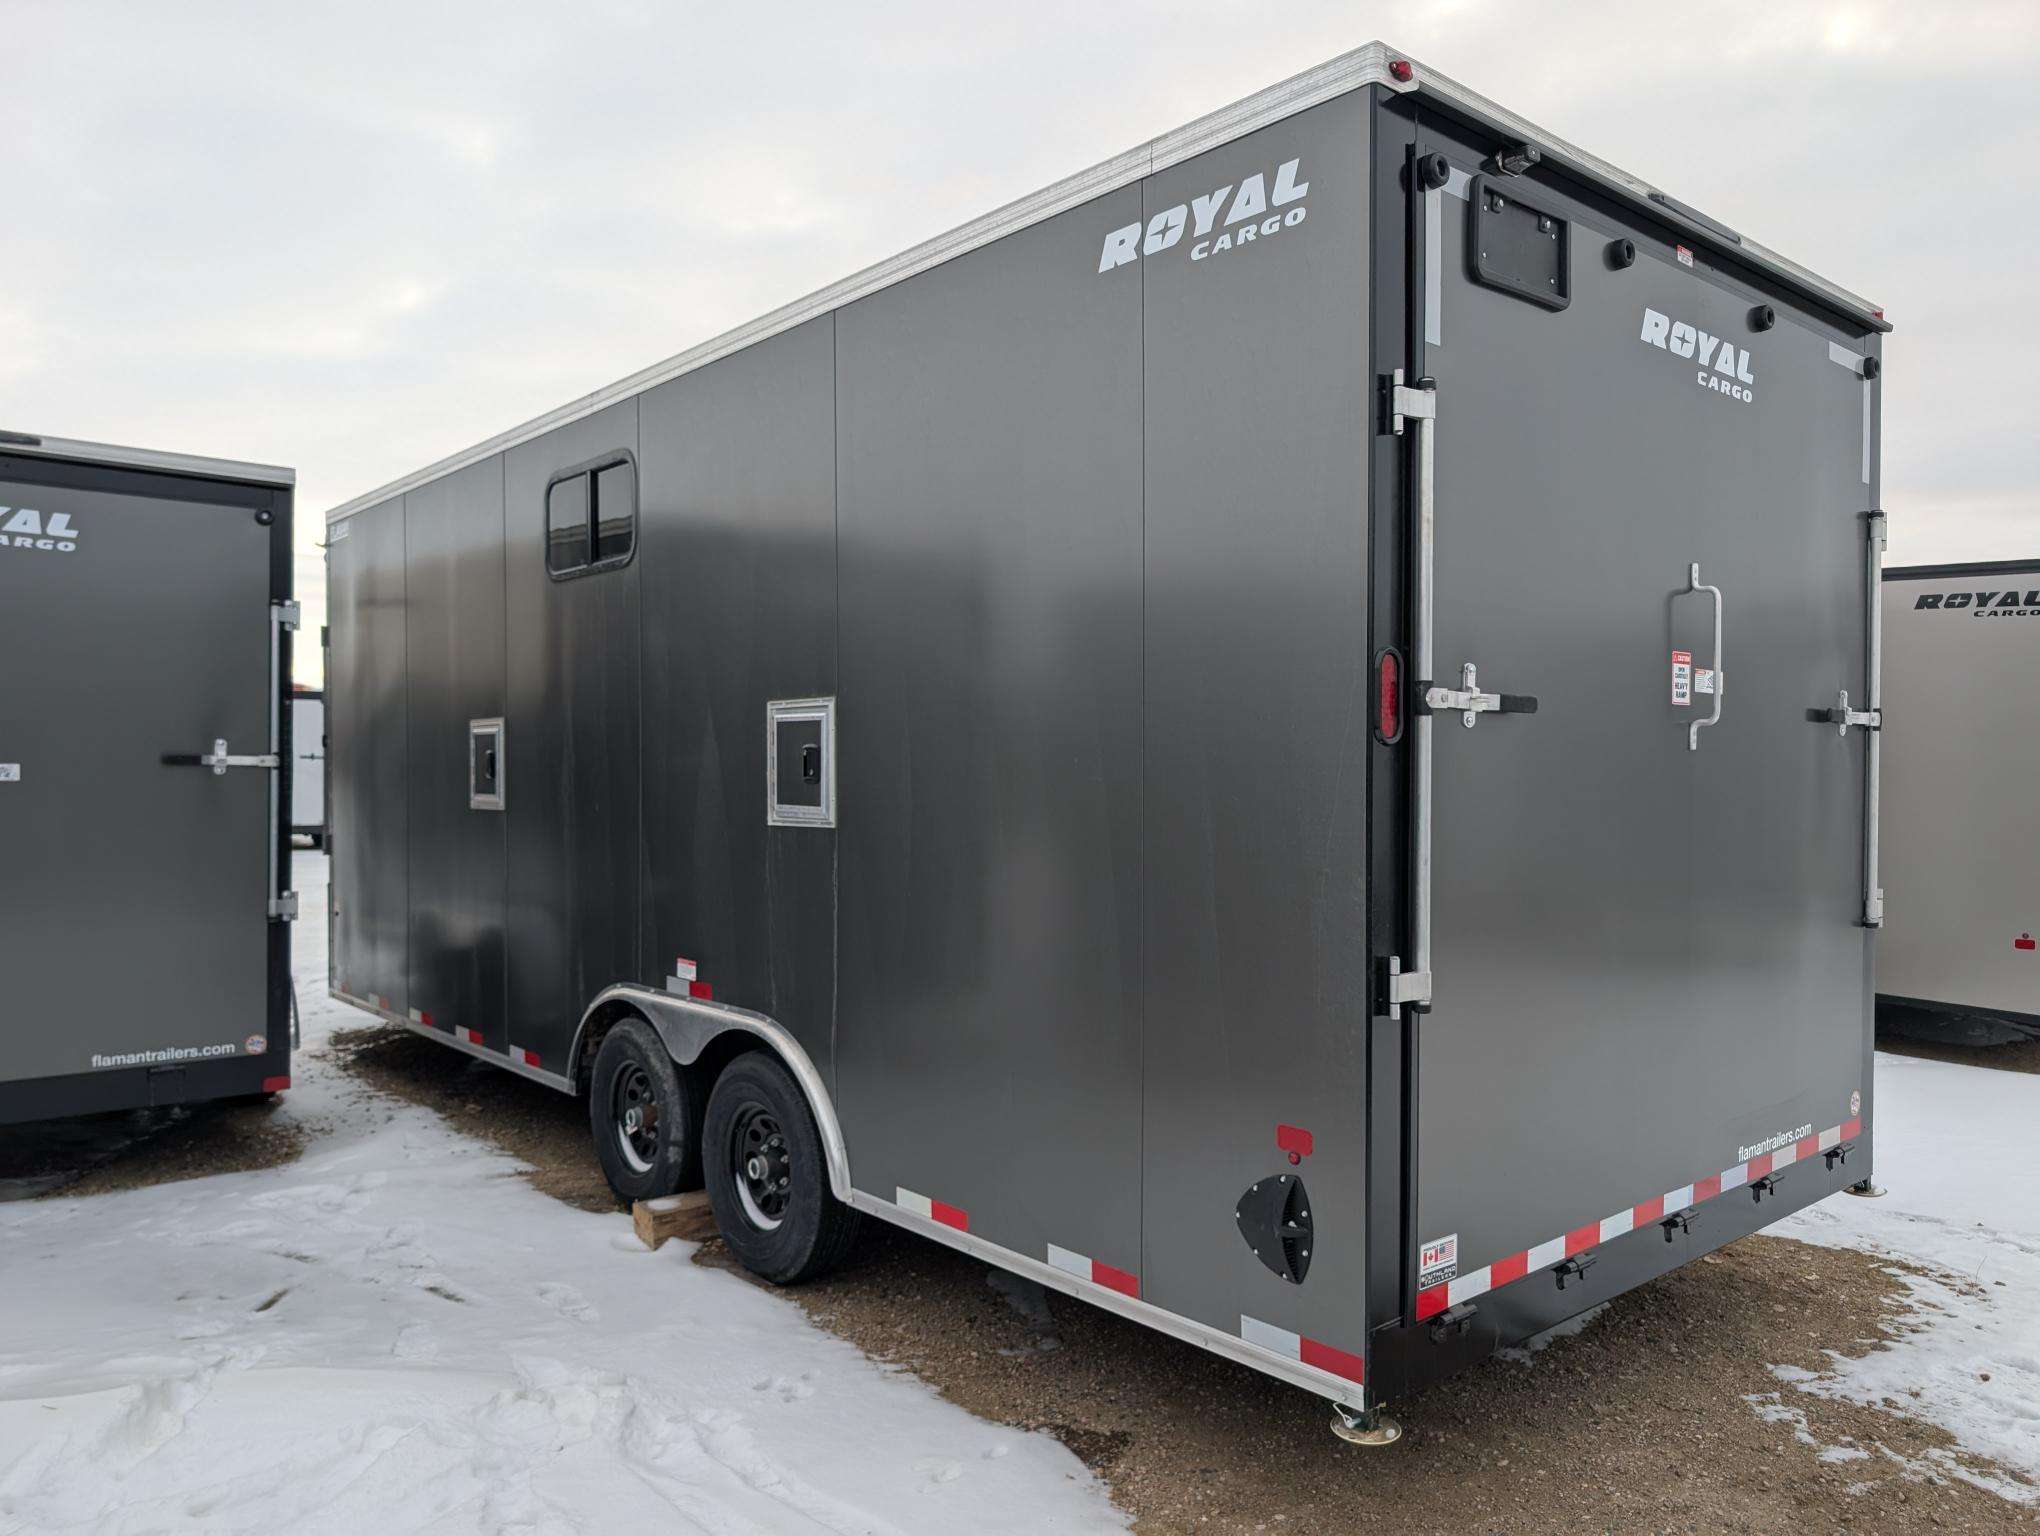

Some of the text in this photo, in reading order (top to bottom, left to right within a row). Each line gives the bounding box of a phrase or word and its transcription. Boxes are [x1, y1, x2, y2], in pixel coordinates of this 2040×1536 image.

[1098, 158, 1309, 274] ROYAL
[1190, 207, 1307, 262] CARGO
[1640, 307, 1754, 385] ROYAL
[1697, 371, 1753, 403] CARGO
[1914, 590, 2040, 610] ROYAL
[1973, 609, 2040, 618] CARGO
[91, 1042, 236, 1068] flamantrailers.com
[1738, 1123, 1812, 1163] flamantrailers.com
[1420, 1265, 1456, 1282] SOUTHLAND
